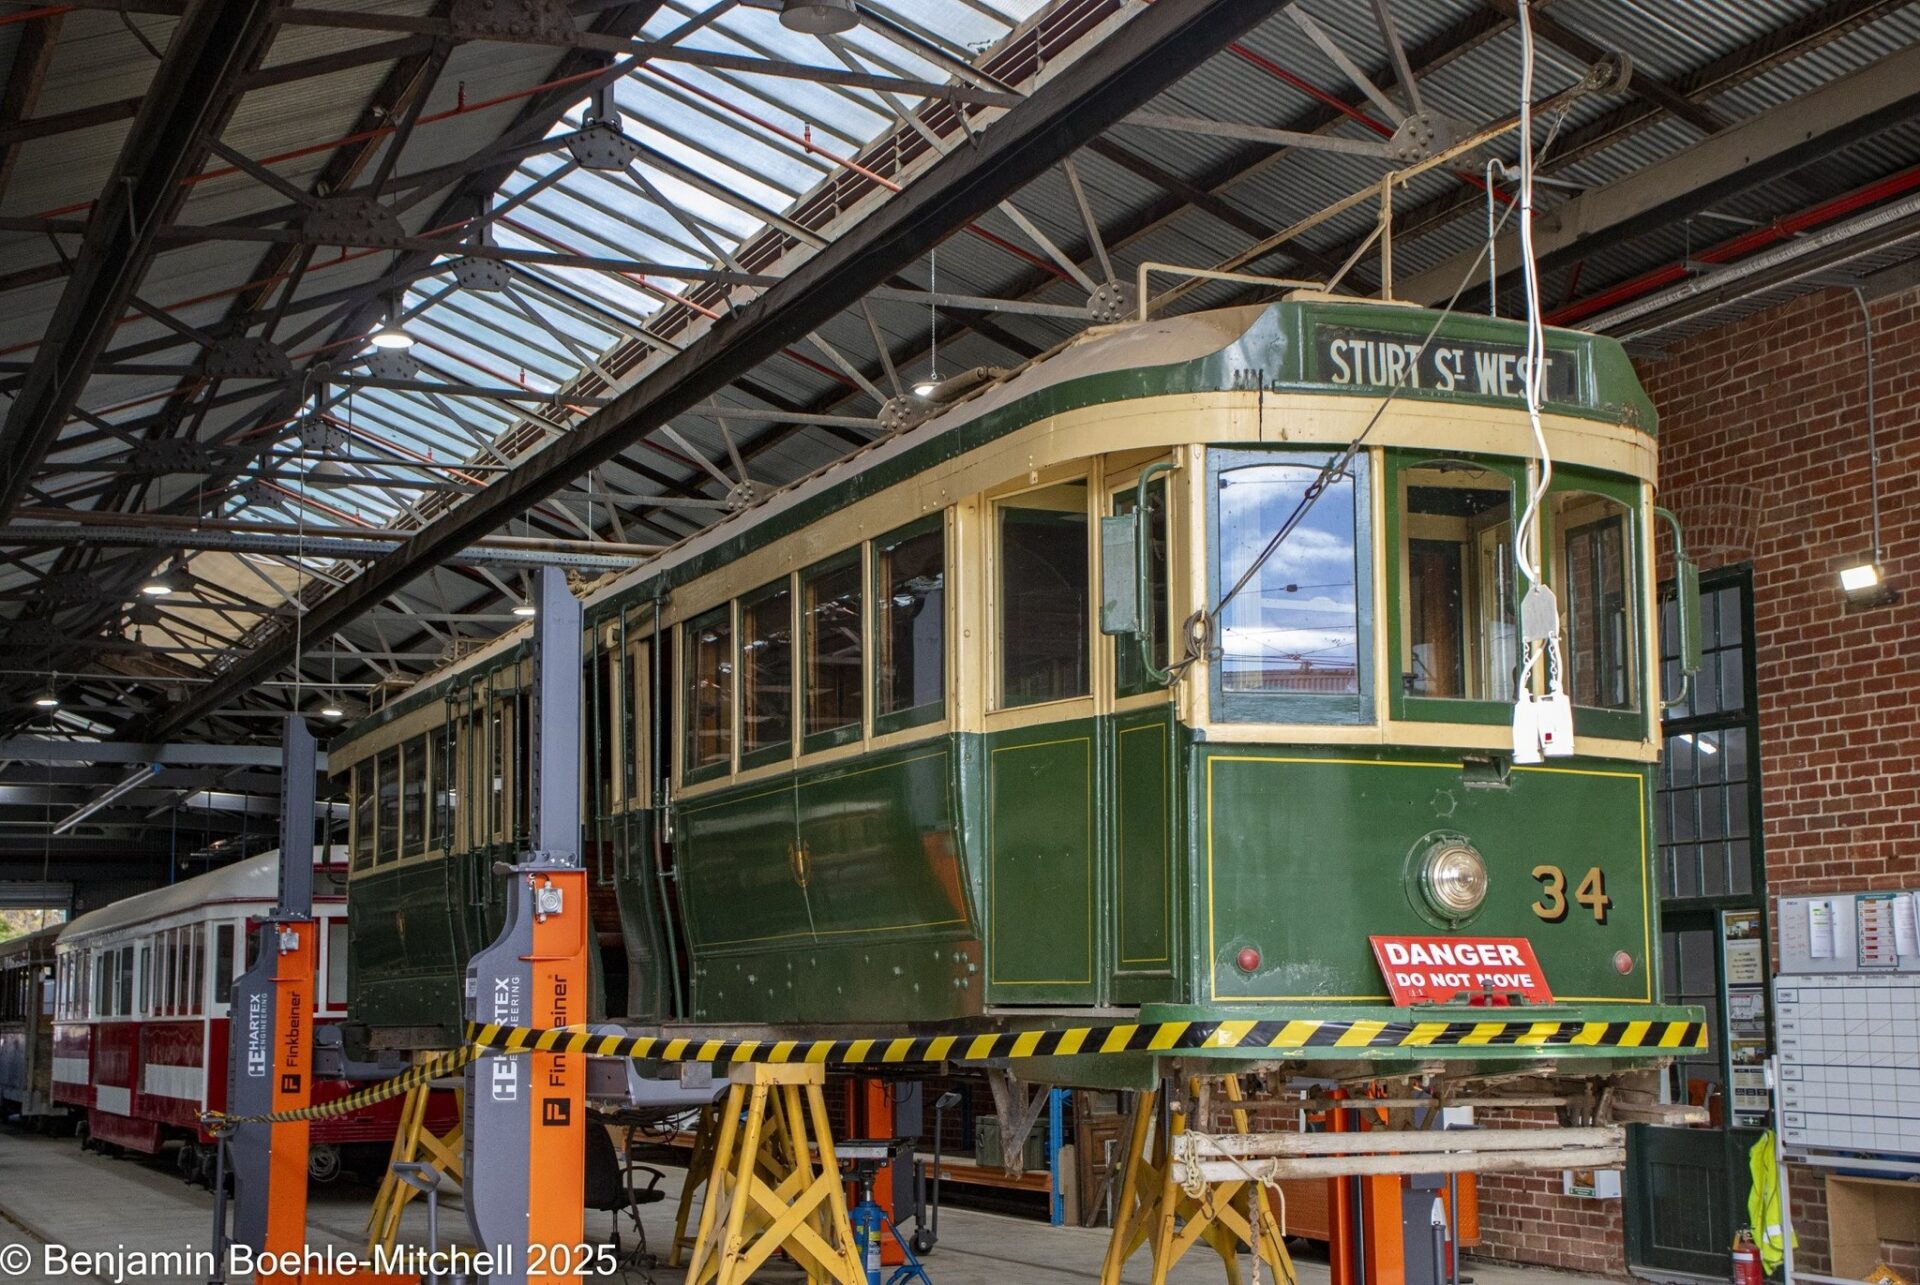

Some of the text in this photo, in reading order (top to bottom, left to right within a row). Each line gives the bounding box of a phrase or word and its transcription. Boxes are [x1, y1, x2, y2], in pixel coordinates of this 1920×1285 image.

[1330, 338, 1422, 389] STURT
[1474, 351, 1553, 402] WEST
[1531, 864, 1611, 924] 34
[1384, 942, 1527, 967] DANGER
[1395, 972, 1426, 988] DO
[1428, 972, 1471, 988] NOT
[248, 993, 261, 1050] HARTEX
[260, 992, 268, 1050] ENGINEERING
[286, 991, 301, 1067] Finkbeiner
[547, 974, 567, 1087] Fineiner
